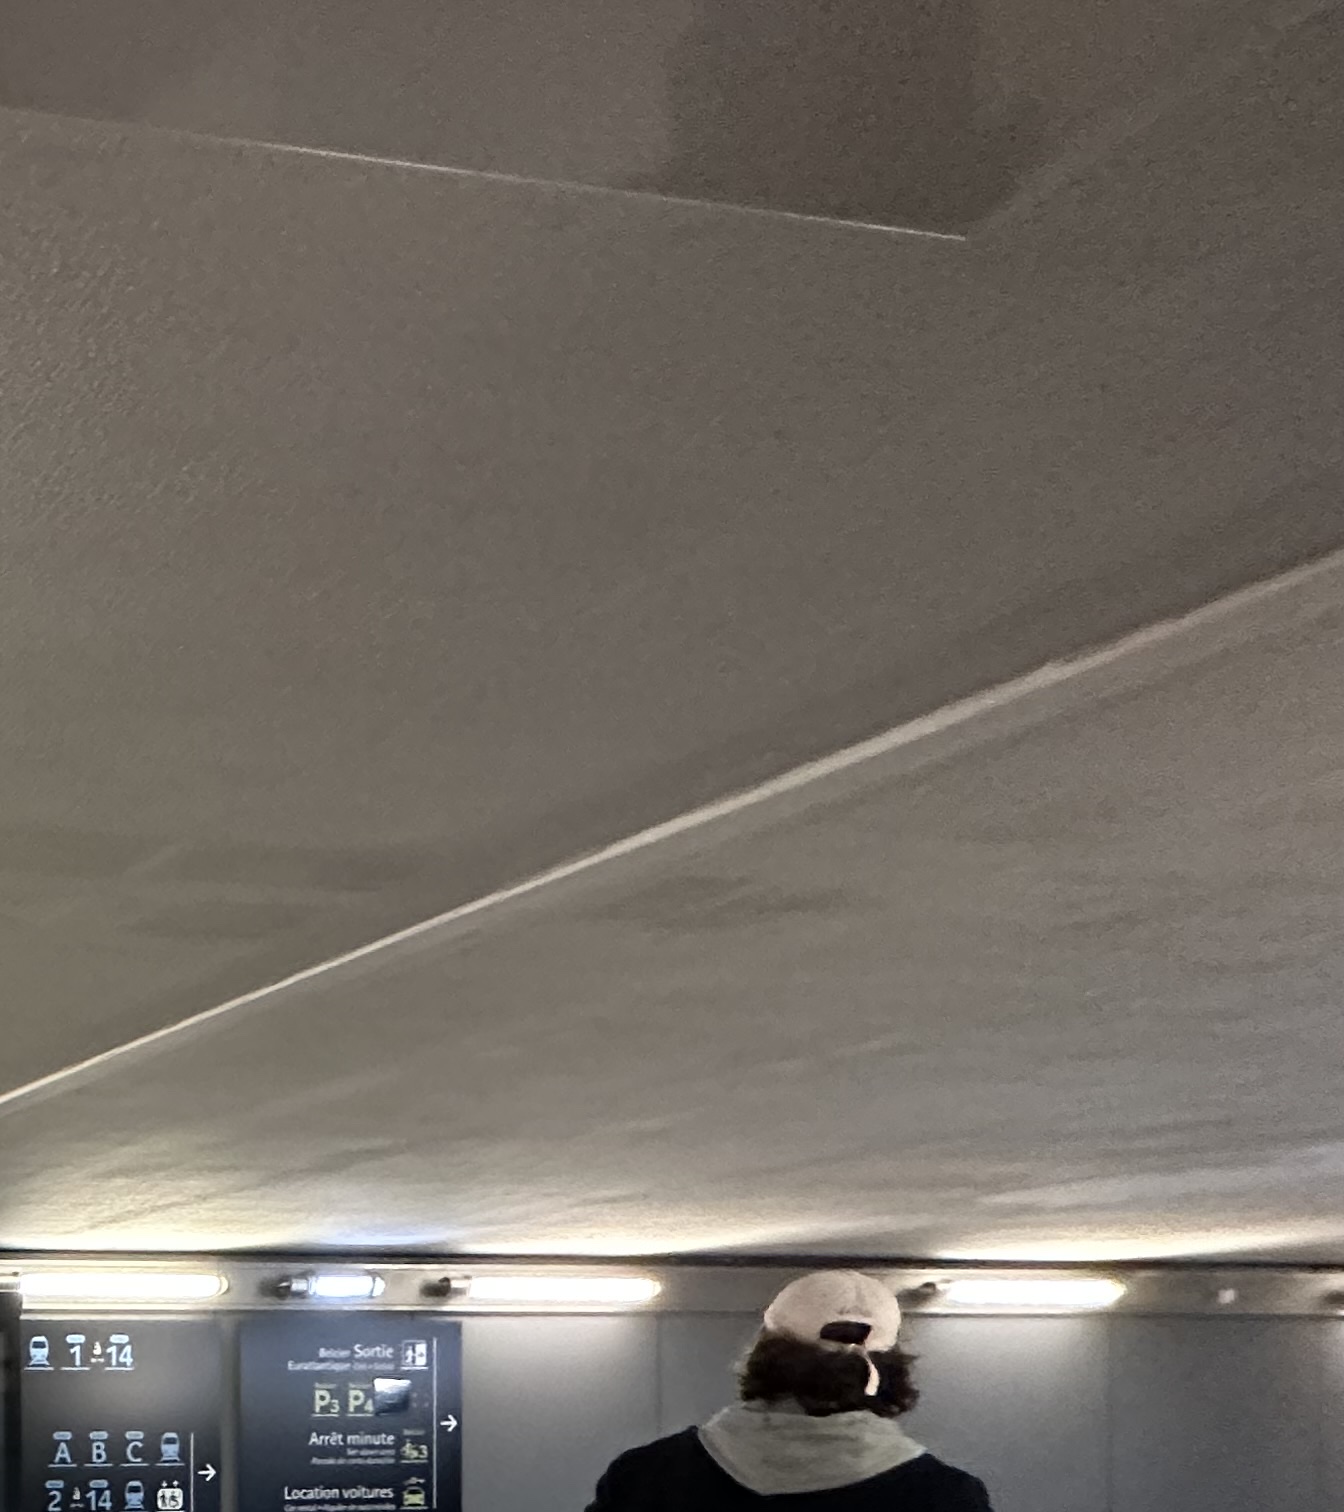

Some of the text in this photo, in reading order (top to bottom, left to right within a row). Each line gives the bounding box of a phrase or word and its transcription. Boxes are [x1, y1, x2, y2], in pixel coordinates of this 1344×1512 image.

[70, 1345, 81, 1366] 1
[106, 1345, 134, 1366] 14
[353, 1344, 394, 1358] Sortie
[315, 1389, 374, 1413] P3 P4
[308, 1432, 344, 1446] Arrêt
[347, 1432, 395, 1446] minute
[54, 1441, 144, 1463] A B C
[48, 1490, 62, 1512] 2
[85, 1490, 112, 1511] 14
[284, 1485, 395, 1500] Location voitures
